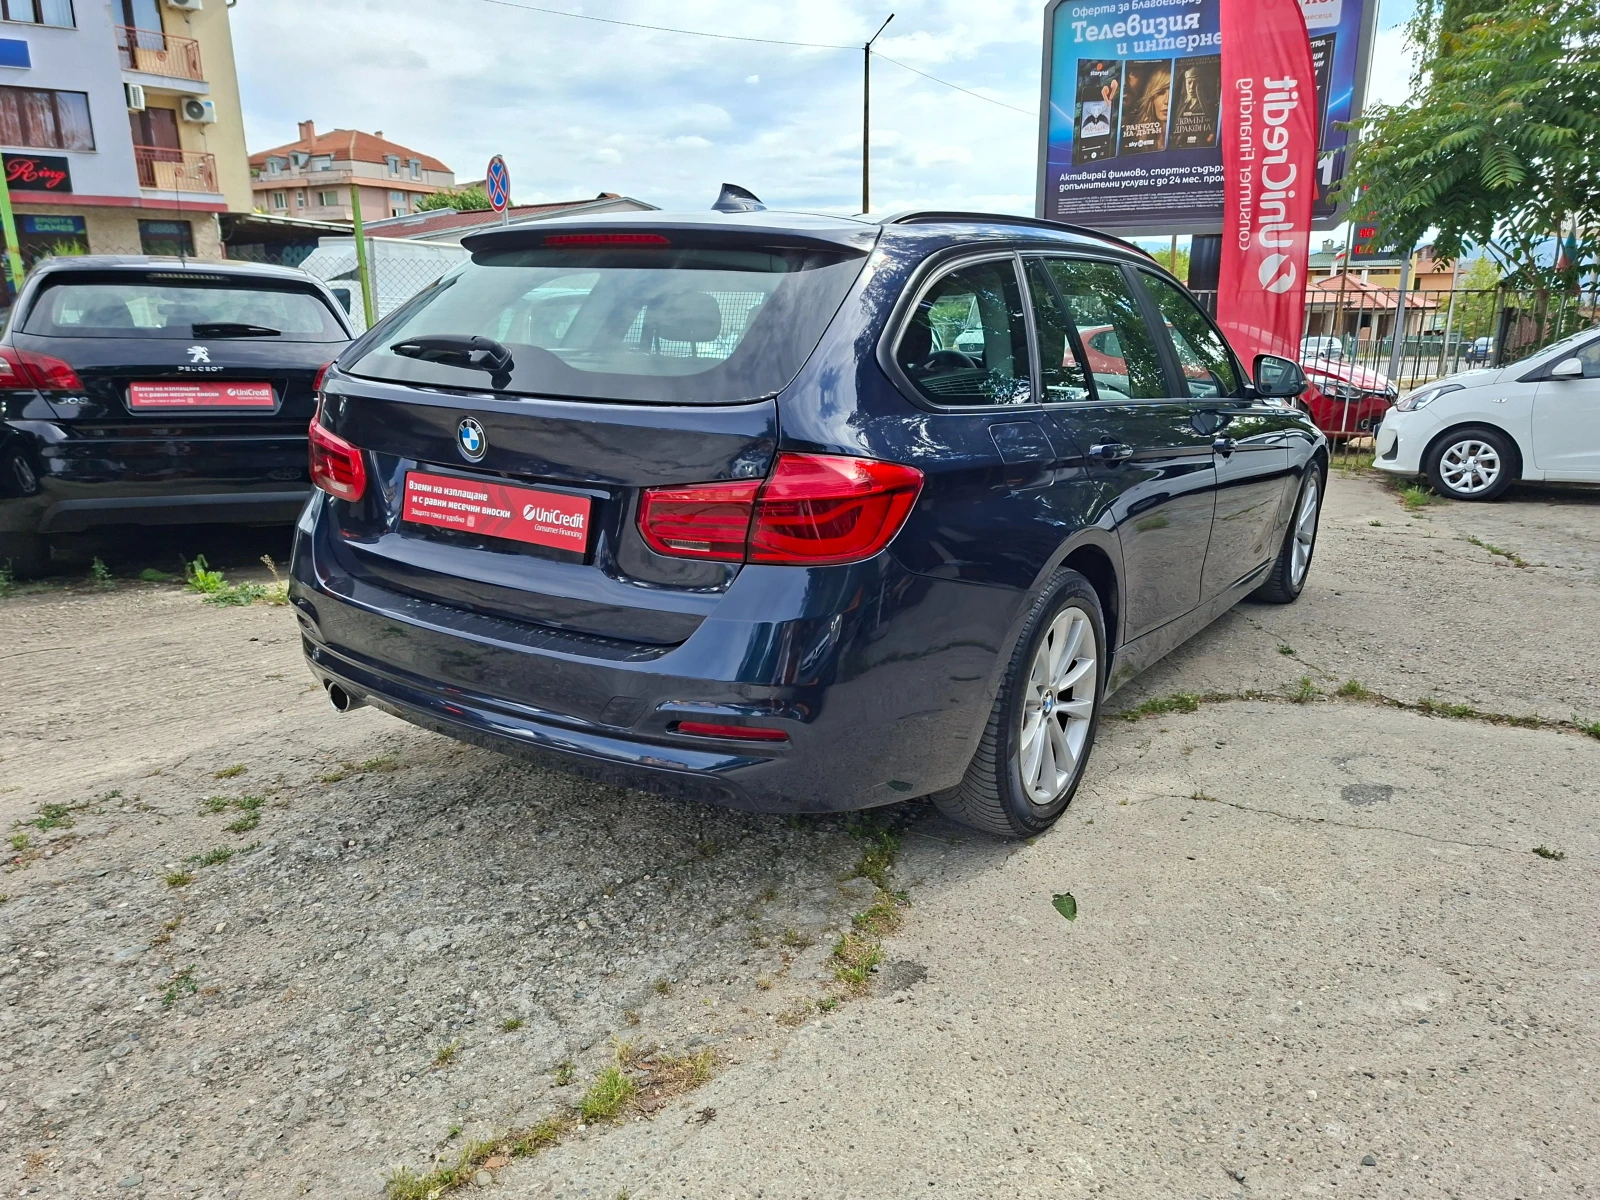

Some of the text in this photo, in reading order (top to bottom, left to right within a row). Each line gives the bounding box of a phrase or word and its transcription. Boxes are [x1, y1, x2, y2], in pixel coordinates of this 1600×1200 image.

[1072, 5, 1116, 18] Оферта
[1117, 3, 1130, 14] за
[1072, 13, 1200, 43] Телевизия
[1116, 32, 1222, 55] и интерне
[1126, 121, 1160, 131] РАНЧОТО
[1059, 170, 1107, 181] Активирай
[1108, 168, 1149, 179] филмово,
[1150, 166, 1190, 176] спортно
[1059, 180, 1120, 192] допълнителни
[1121, 179, 1148, 188] услуги
[1156, 178, 1168, 187] до
[1169, 176, 1181, 184] 24
[236, 388, 269, 396] UniCredit
[408, 480, 488, 501] Вземи на изплащане
[424, 497, 447, 507] равни
[447, 500, 480, 513] месечни
[481, 507, 511, 518] вноски
[535, 506, 584, 528] UniCredit
[534, 523, 583, 540] Consumer Financing
